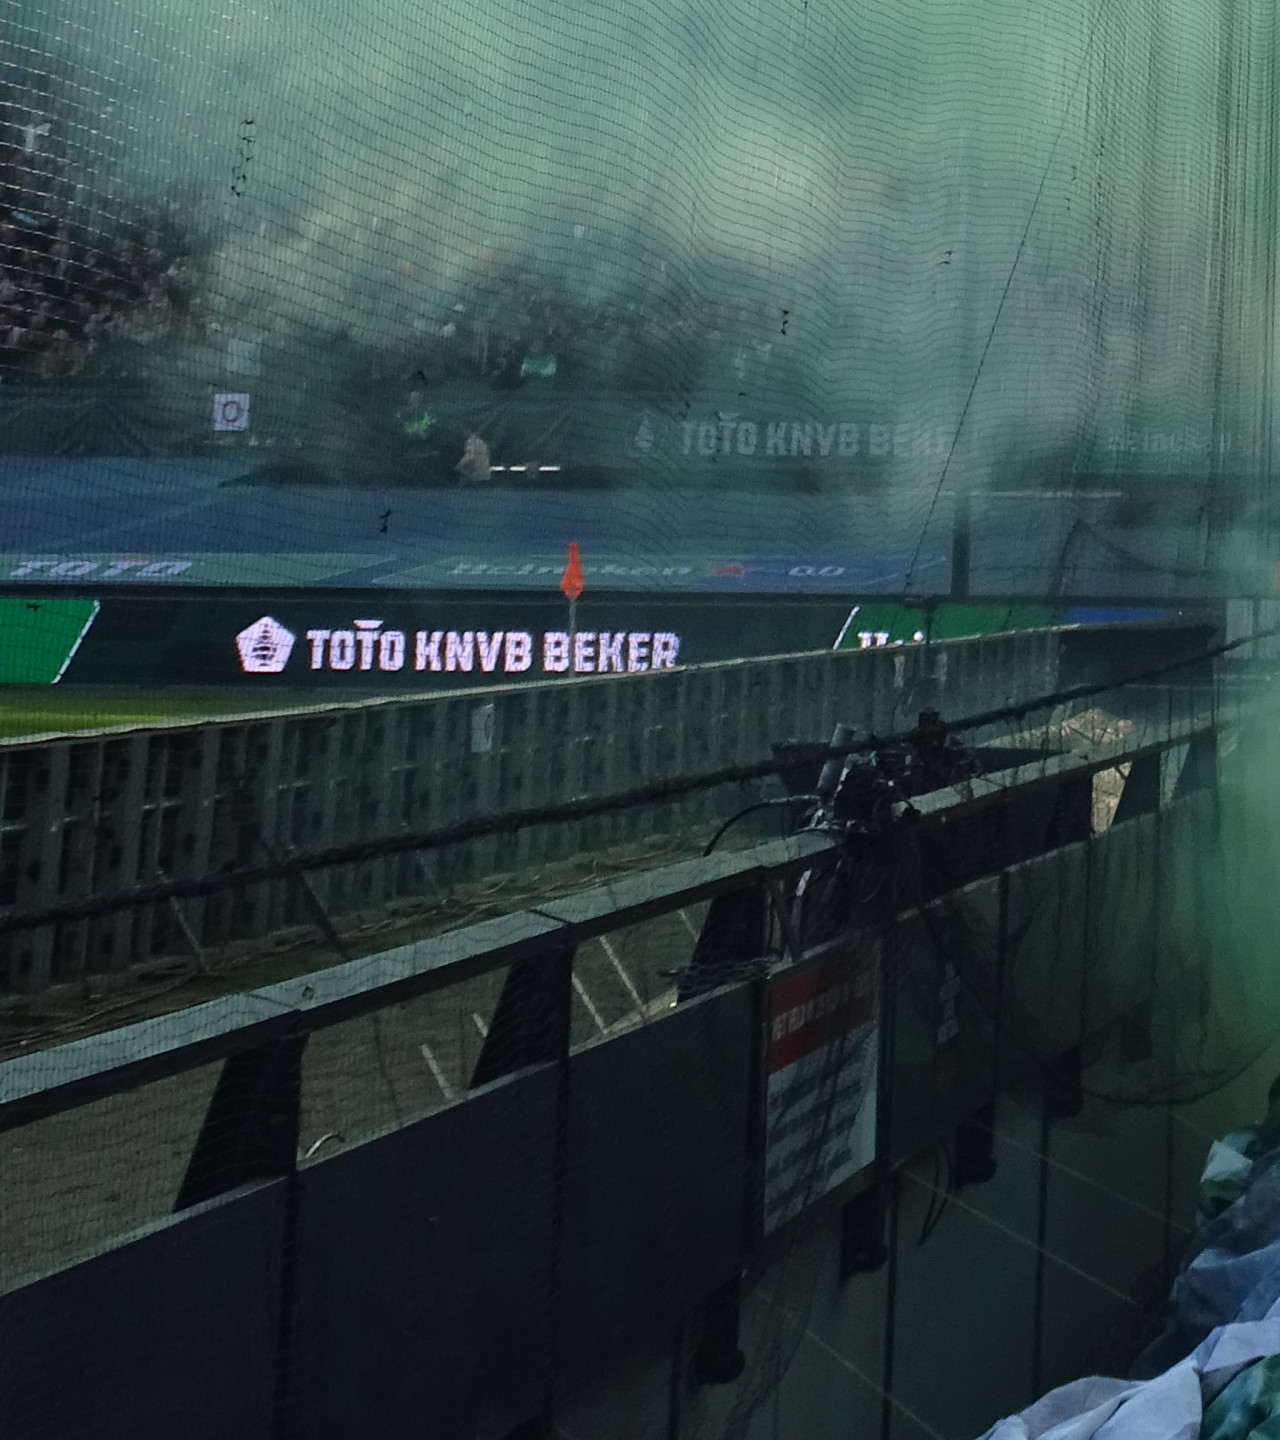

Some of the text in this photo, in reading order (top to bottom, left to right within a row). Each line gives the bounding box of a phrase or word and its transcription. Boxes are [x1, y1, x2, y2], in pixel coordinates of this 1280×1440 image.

[766, 421, 858, 456] KNVB
[305, 619, 682, 674] TOTO KNVB BEKER
